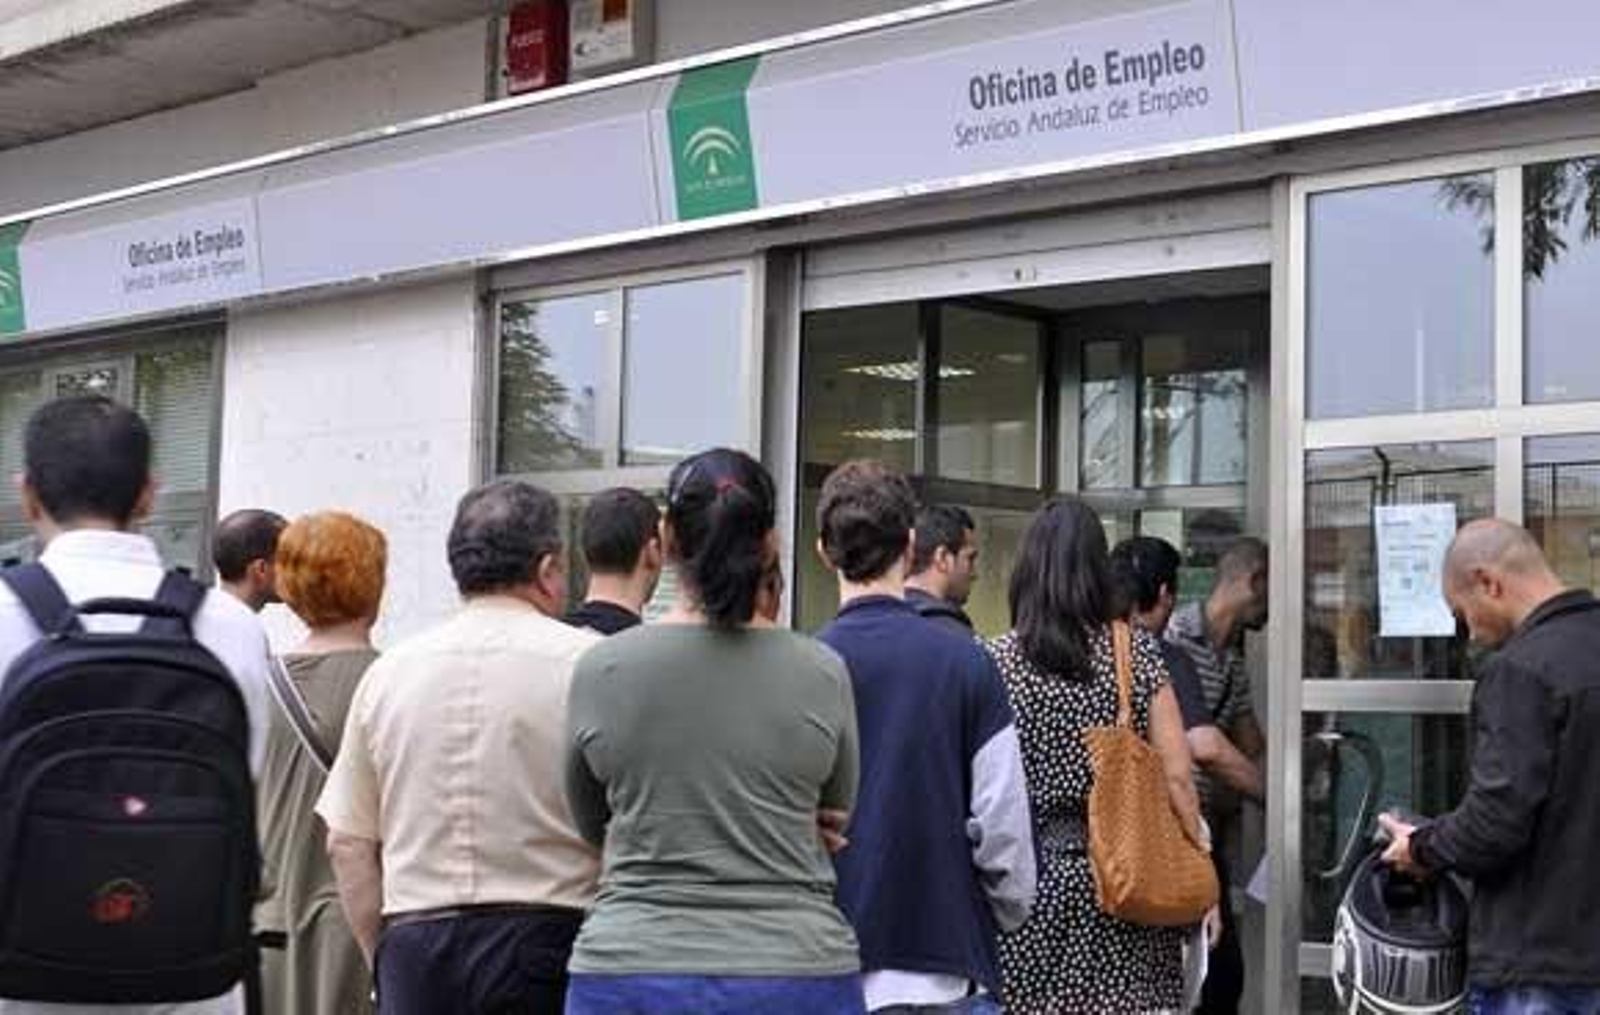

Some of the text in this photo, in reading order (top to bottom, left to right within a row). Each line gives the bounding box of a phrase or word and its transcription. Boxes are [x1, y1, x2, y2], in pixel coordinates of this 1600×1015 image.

[969, 41, 1206, 110] Oficina de Empleo
[955, 85, 1209, 147] Servicio Andaluz de Empleo
[128, 222, 244, 267] Oficina de Empleo
